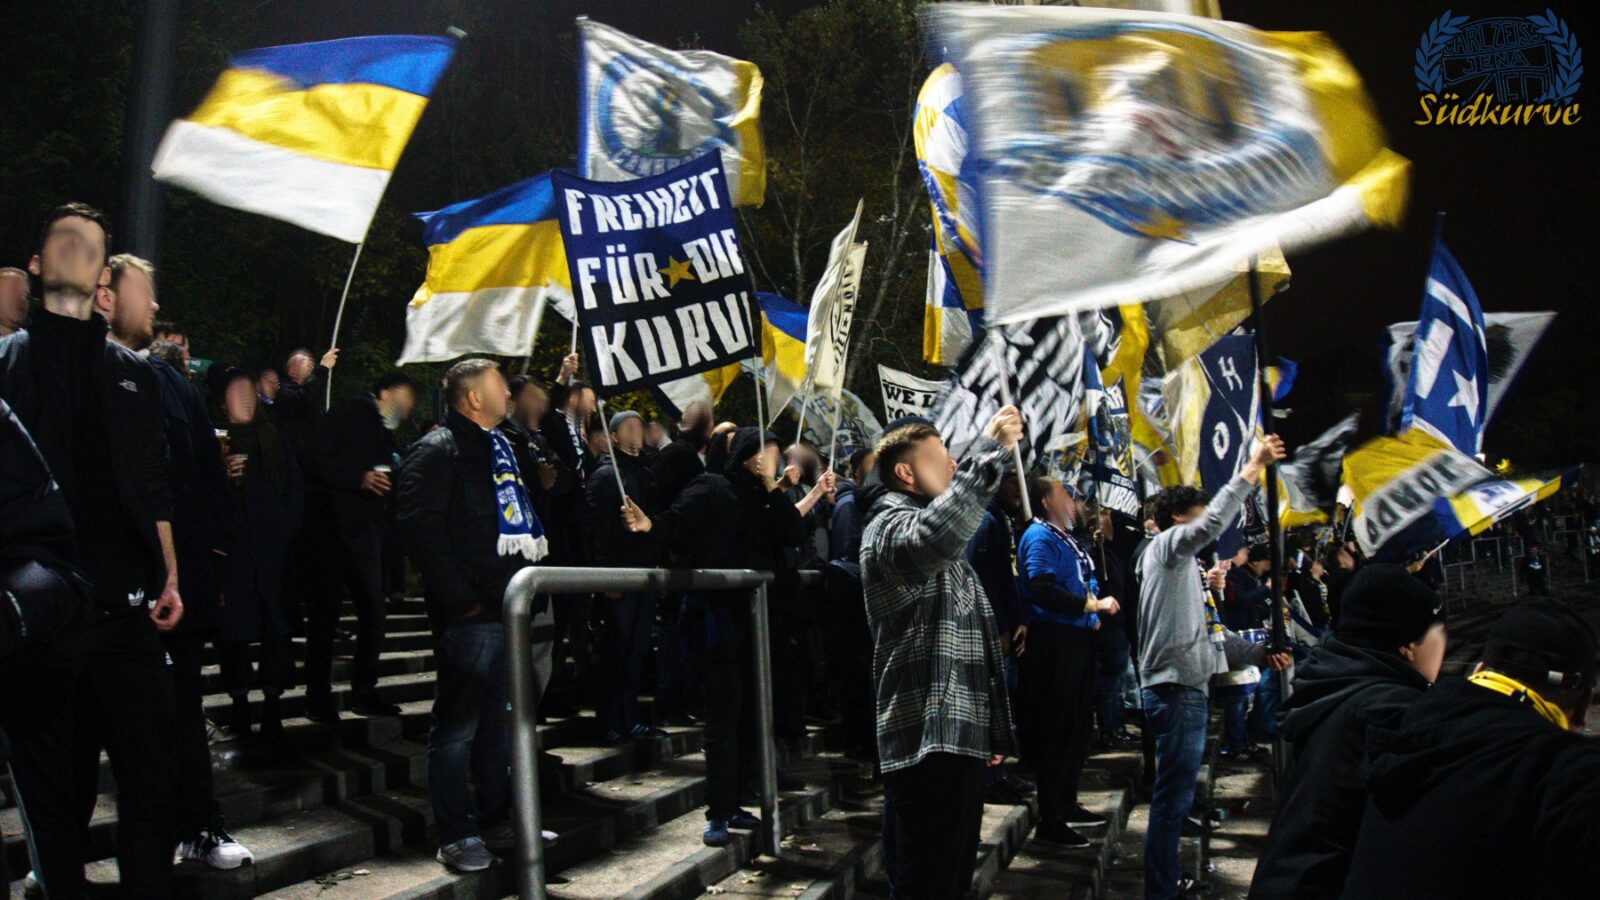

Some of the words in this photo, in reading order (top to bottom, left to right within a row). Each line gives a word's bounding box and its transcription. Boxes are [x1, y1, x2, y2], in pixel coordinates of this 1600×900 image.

[564, 167, 720, 235] FREIHEIT
[577, 244, 671, 310] FÜR
[883, 383, 915, 405] WE
